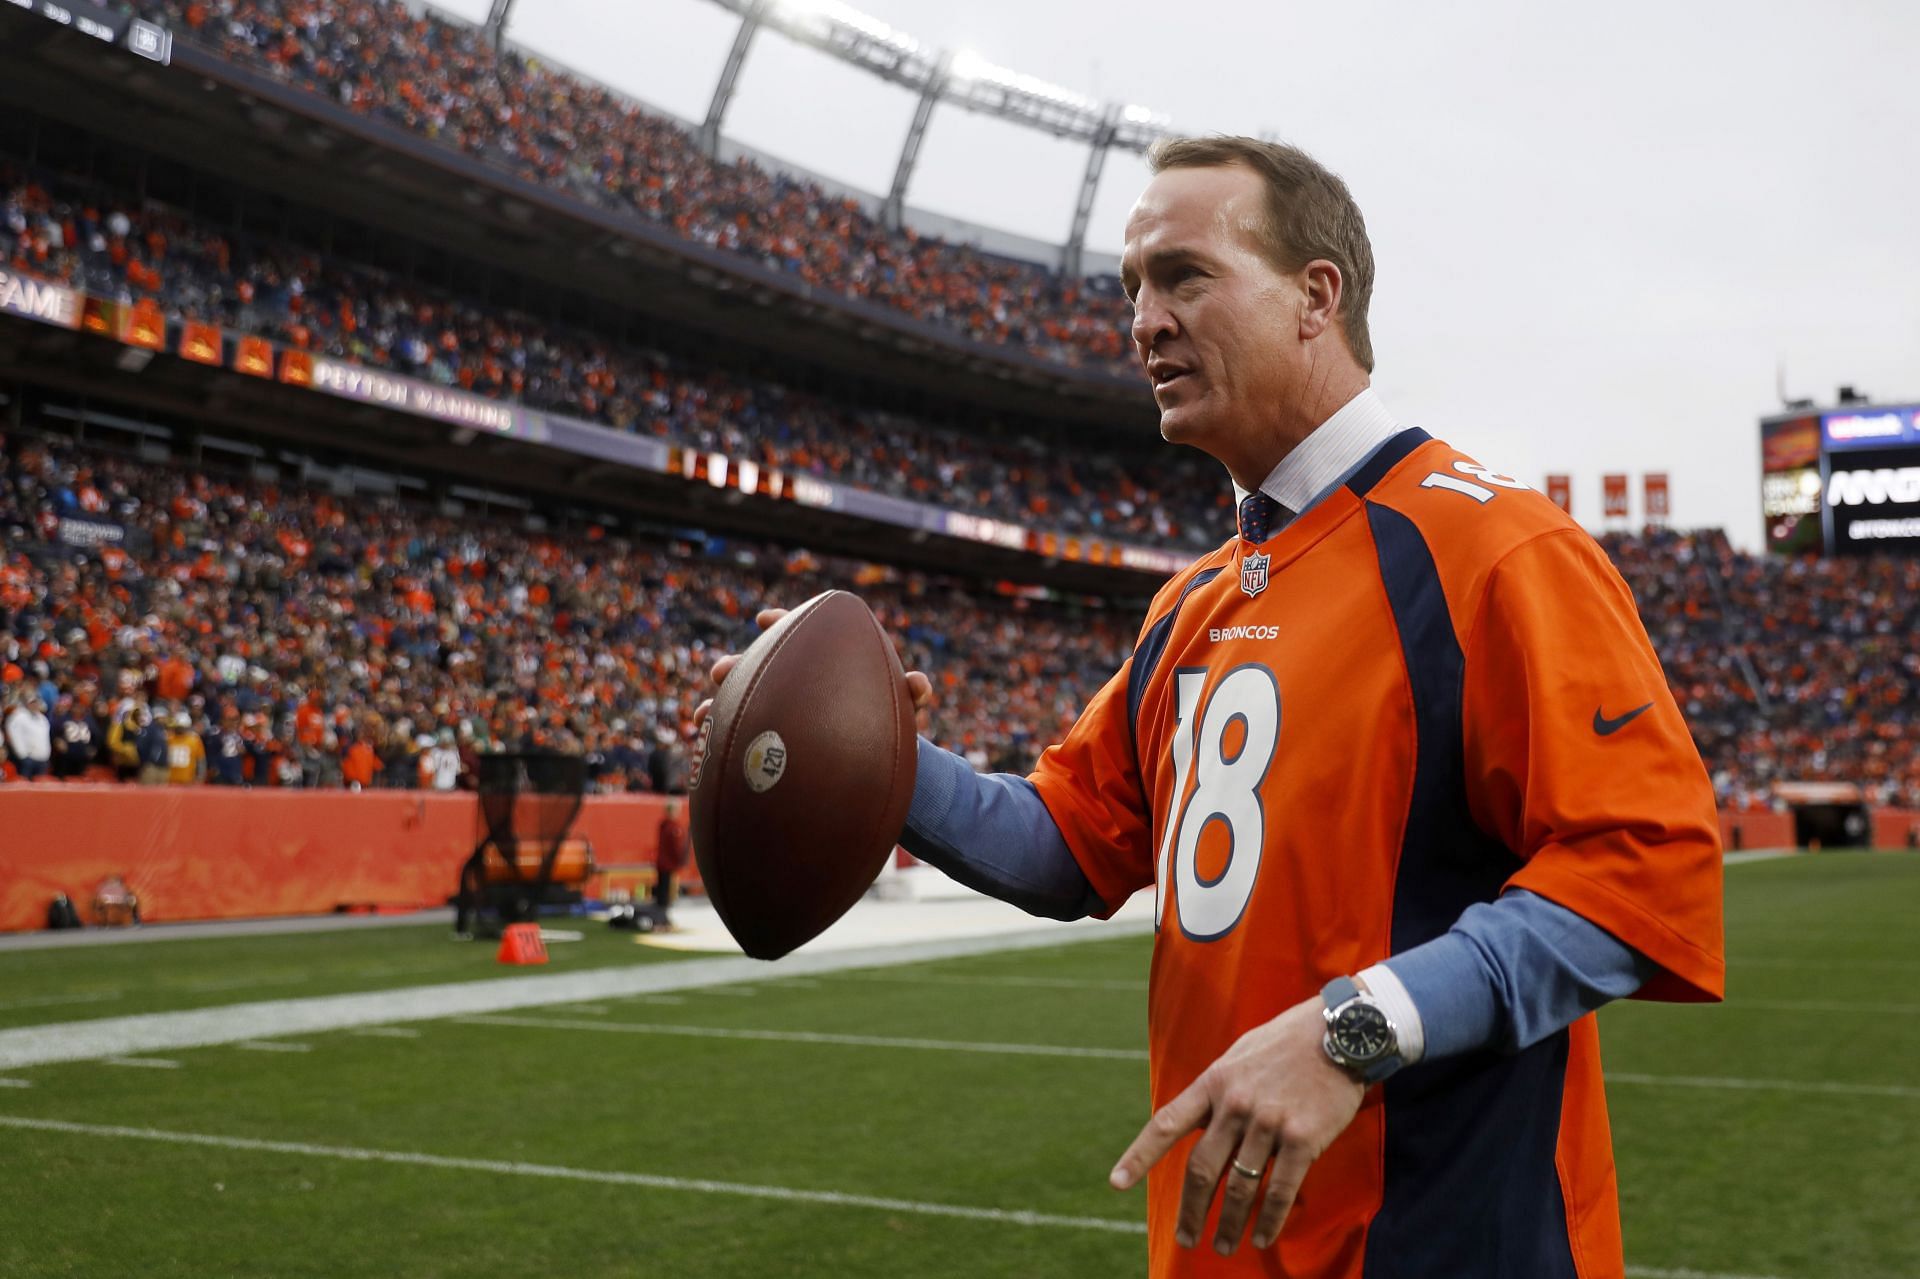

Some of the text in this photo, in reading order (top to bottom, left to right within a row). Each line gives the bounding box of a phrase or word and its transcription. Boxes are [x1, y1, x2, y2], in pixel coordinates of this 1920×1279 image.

[314, 362, 512, 431] PEYTON MANNING
[1418, 461, 1533, 505] 18
[1244, 570, 1265, 590] NFL
[1209, 625, 1280, 642] BRONCOS
[1155, 662, 1282, 942] 18
